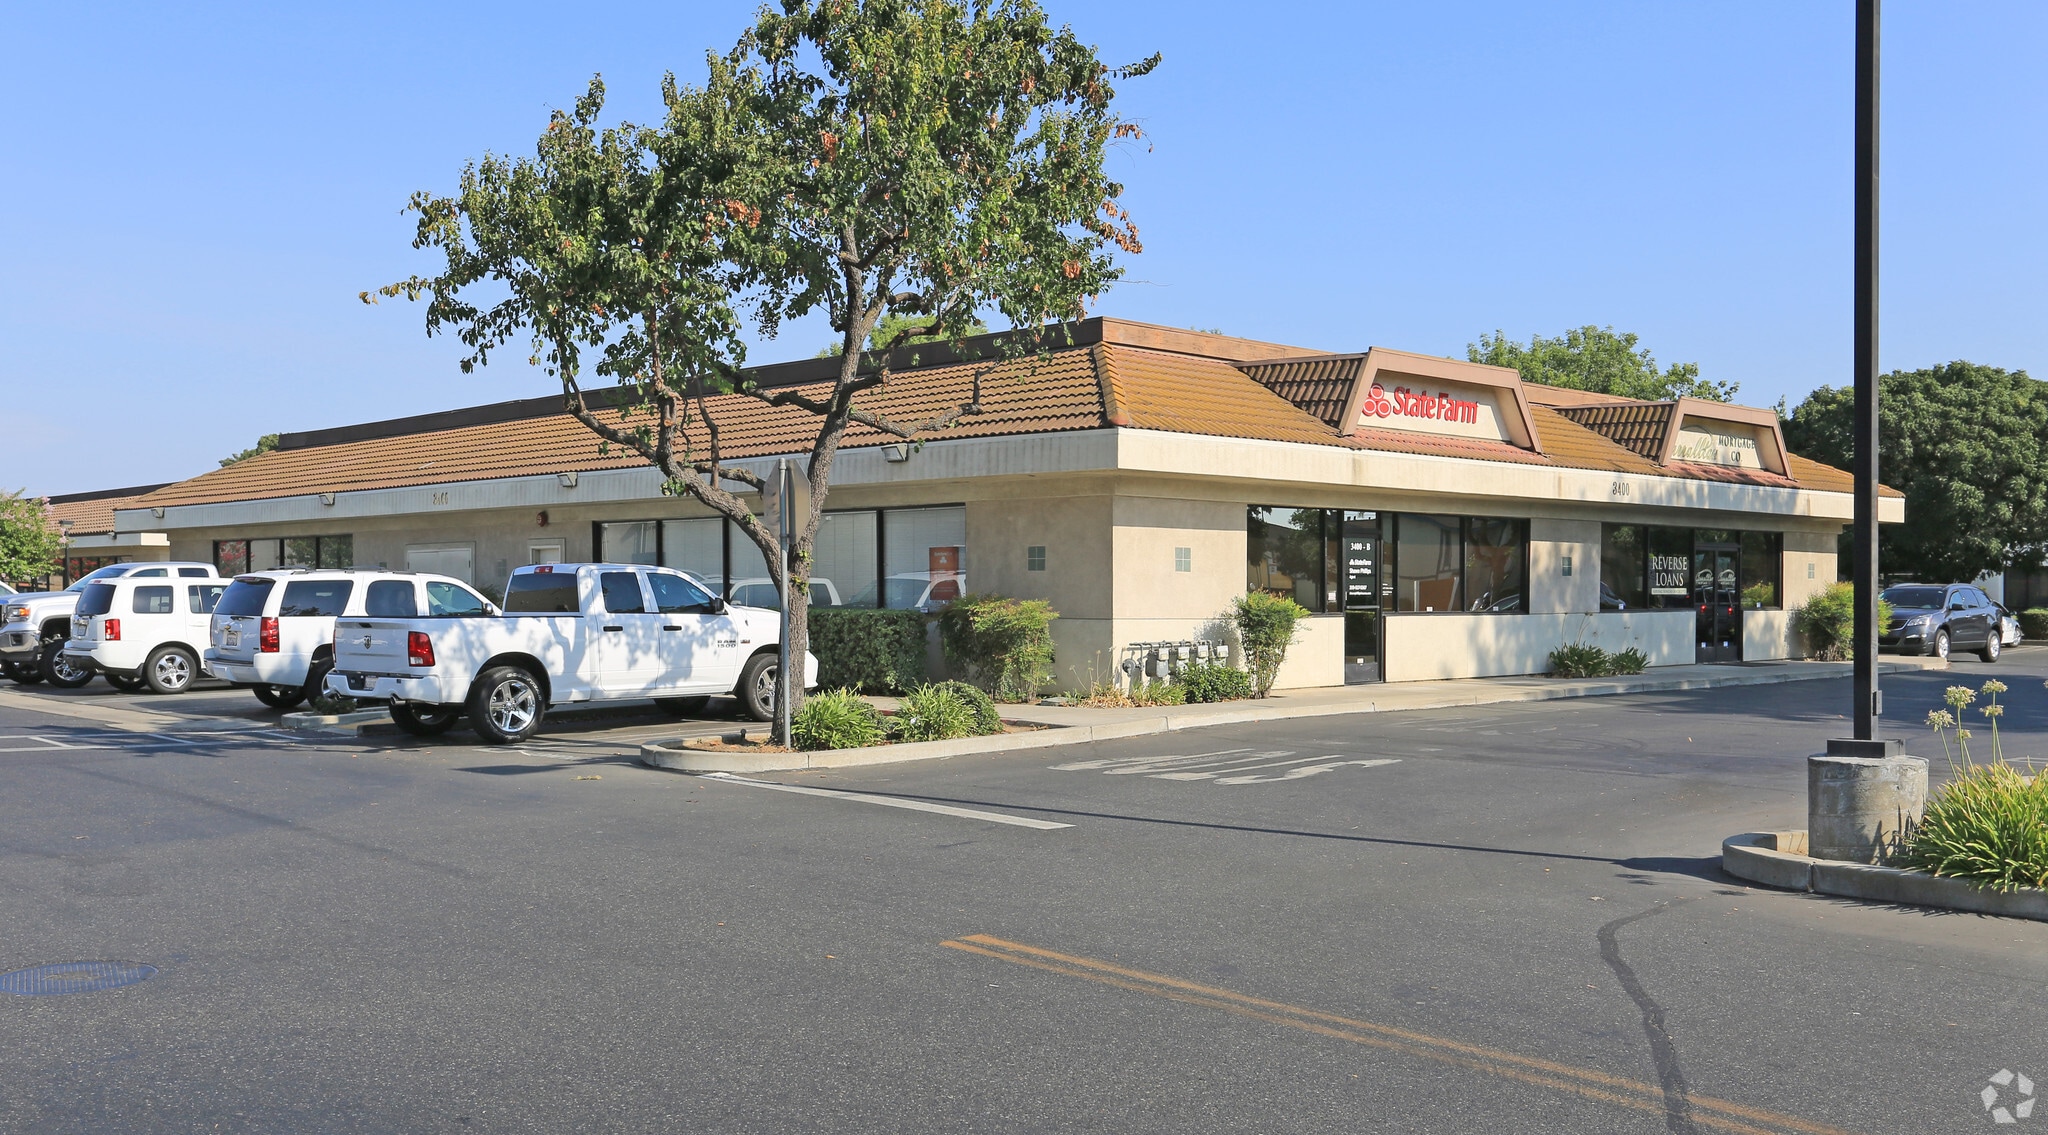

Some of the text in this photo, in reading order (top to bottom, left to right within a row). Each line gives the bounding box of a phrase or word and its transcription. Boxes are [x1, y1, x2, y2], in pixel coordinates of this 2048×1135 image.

[1718, 435, 1755, 449] MORTGAGE
[1612, 481, 1630, 496] 3400
[1652, 556, 1688, 571] REVERSE
[1655, 572, 1684, 586] LOANS
